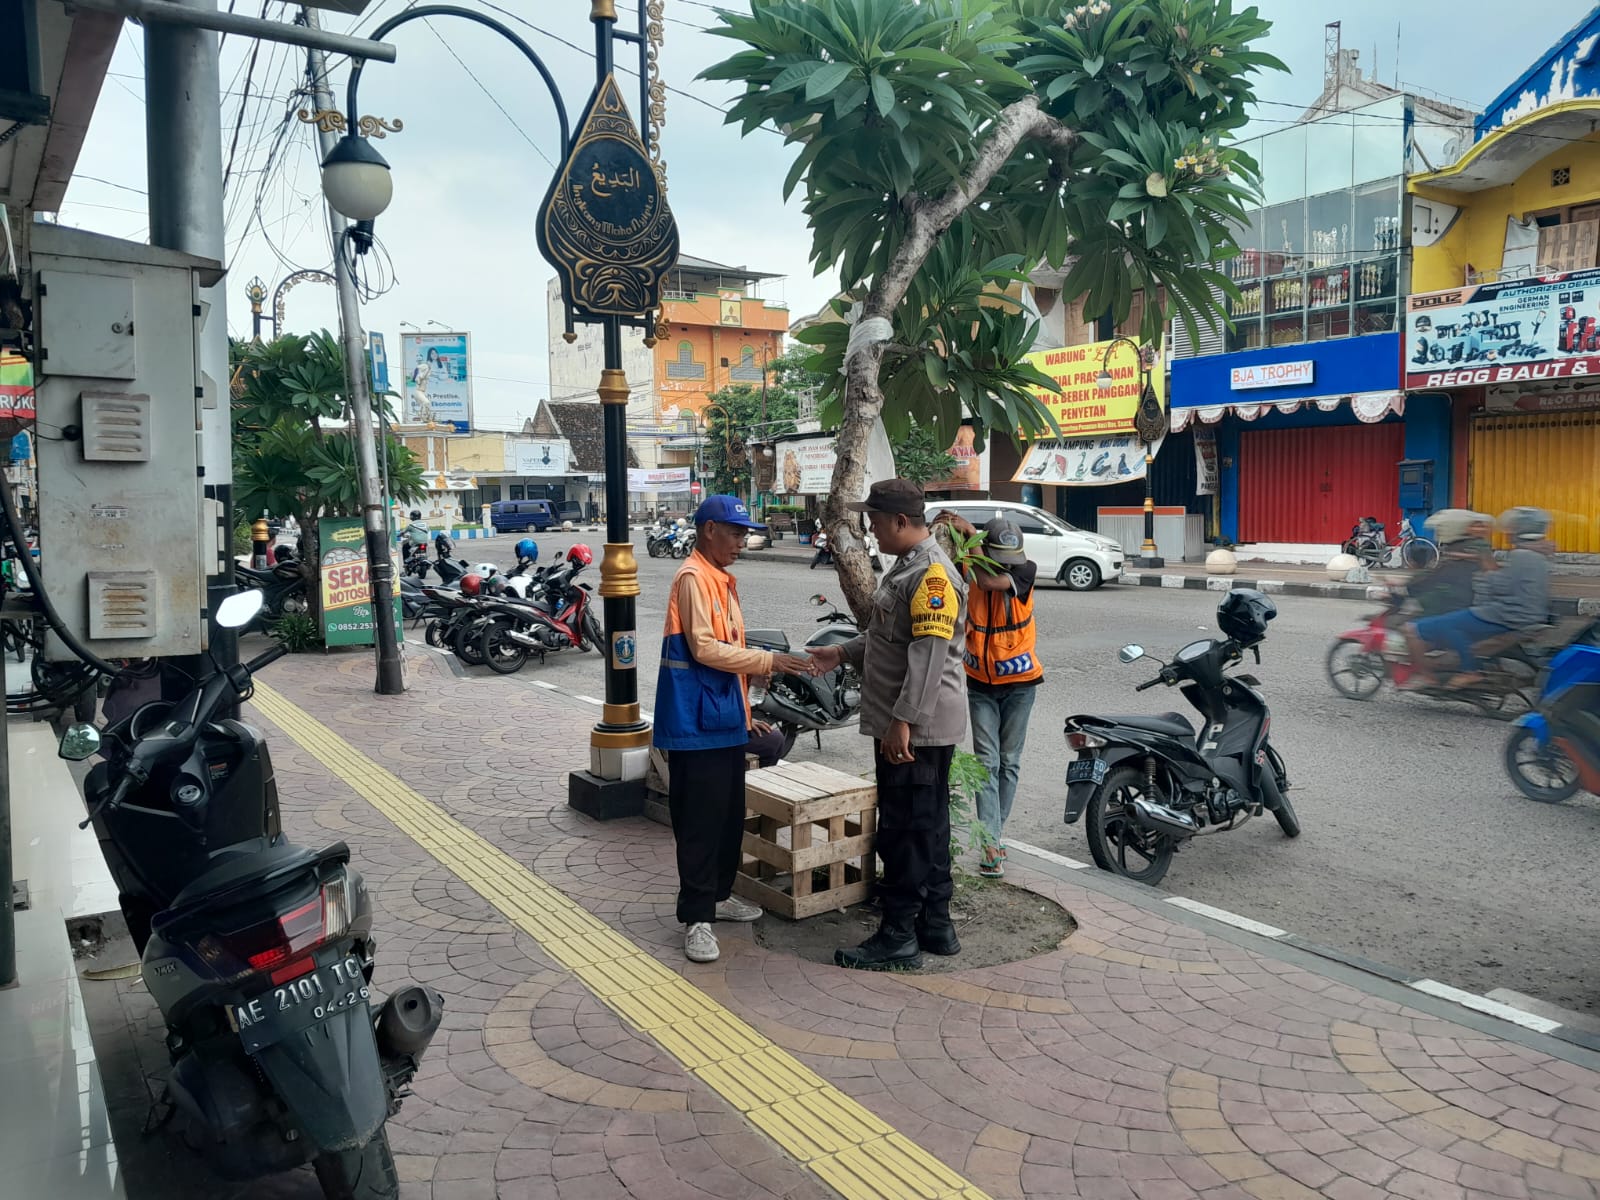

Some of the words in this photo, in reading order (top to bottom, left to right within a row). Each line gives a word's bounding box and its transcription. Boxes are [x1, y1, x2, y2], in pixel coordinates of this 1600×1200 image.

[602, 221, 633, 236] Maha
[1502, 282, 1566, 298] AUTHORIZED
[1567, 279, 1600, 289] DEALE
[1499, 300, 1550, 312] ENGINEERING
[1517, 294, 1550, 304] GERMAN
[1045, 349, 1086, 366] WARUNG
[1074, 366, 1134, 385] PRASANAN
[1232, 368, 1255, 383] BJA
[1260, 361, 1312, 381] TROPHY
[1427, 369, 1491, 388] REOG
[1496, 362, 1566, 382] BAUT
[1571, 360, 1588, 375] &
[1052, 394, 1059, 405] &
[1061, 389, 1090, 404] BEBEK
[1061, 405, 1106, 420] PENYETAN
[951, 446, 977, 458] AYAM
[236, 999, 265, 1030] AE
[274, 974, 324, 1011] 2101
[330, 958, 359, 985] TC
